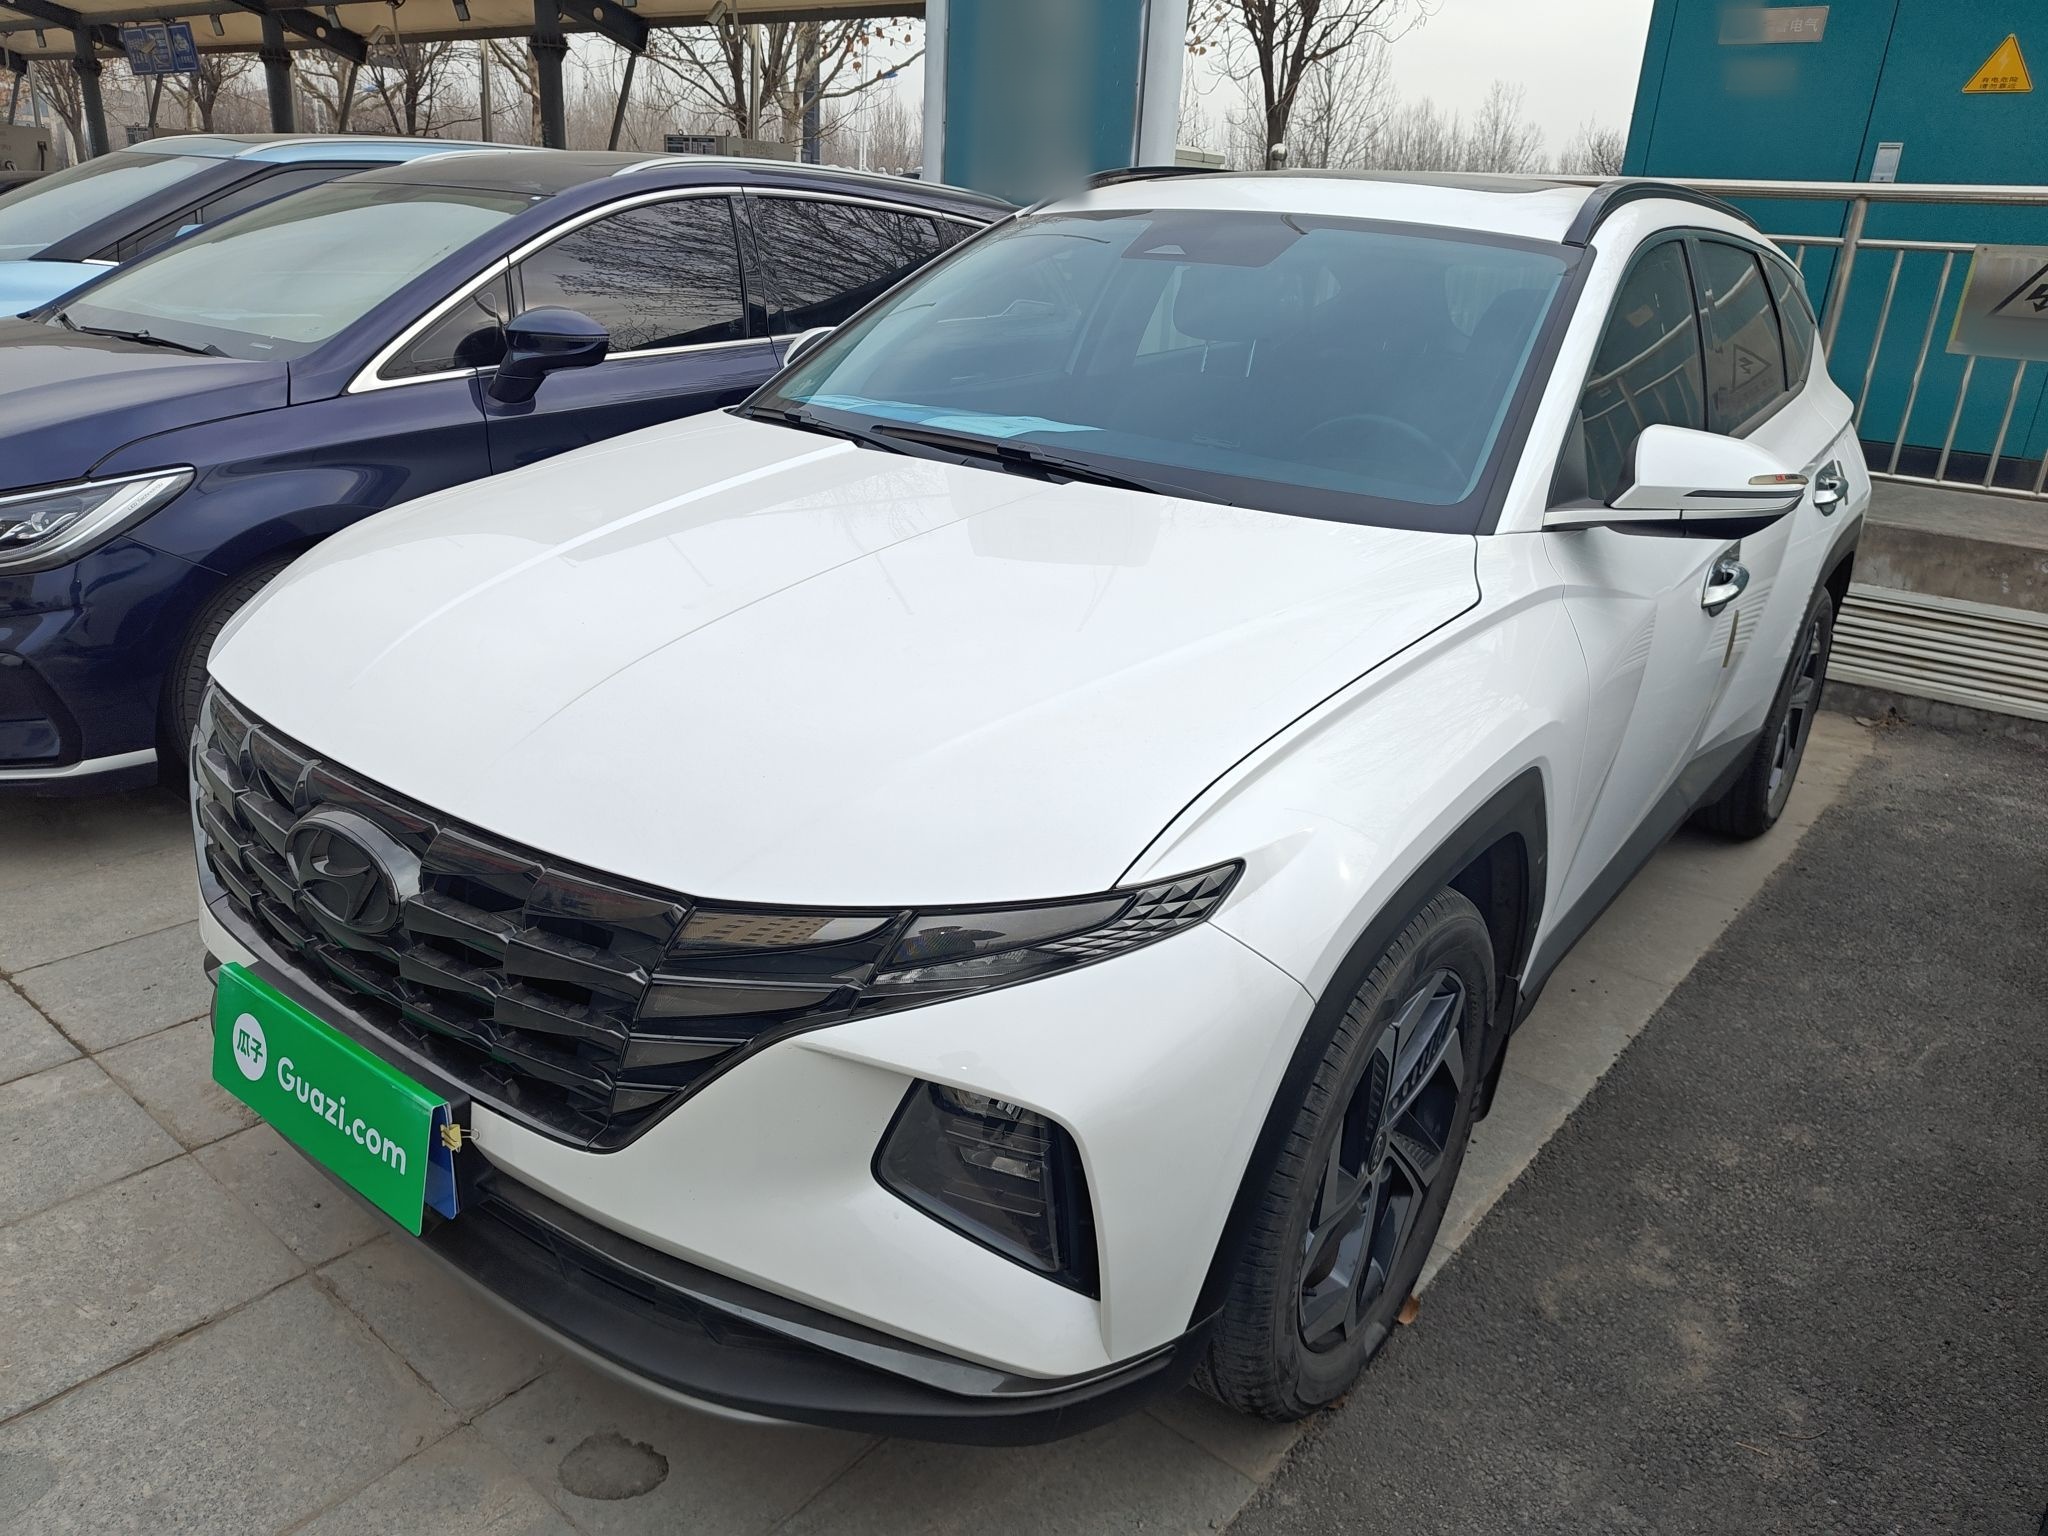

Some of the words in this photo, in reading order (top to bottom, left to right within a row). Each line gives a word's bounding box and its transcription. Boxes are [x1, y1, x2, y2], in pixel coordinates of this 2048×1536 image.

[1780, 18, 1819, 33] 电气
[236, 1028, 264, 1064] 瓜子
[277, 1056, 407, 1176] Guazi.com
